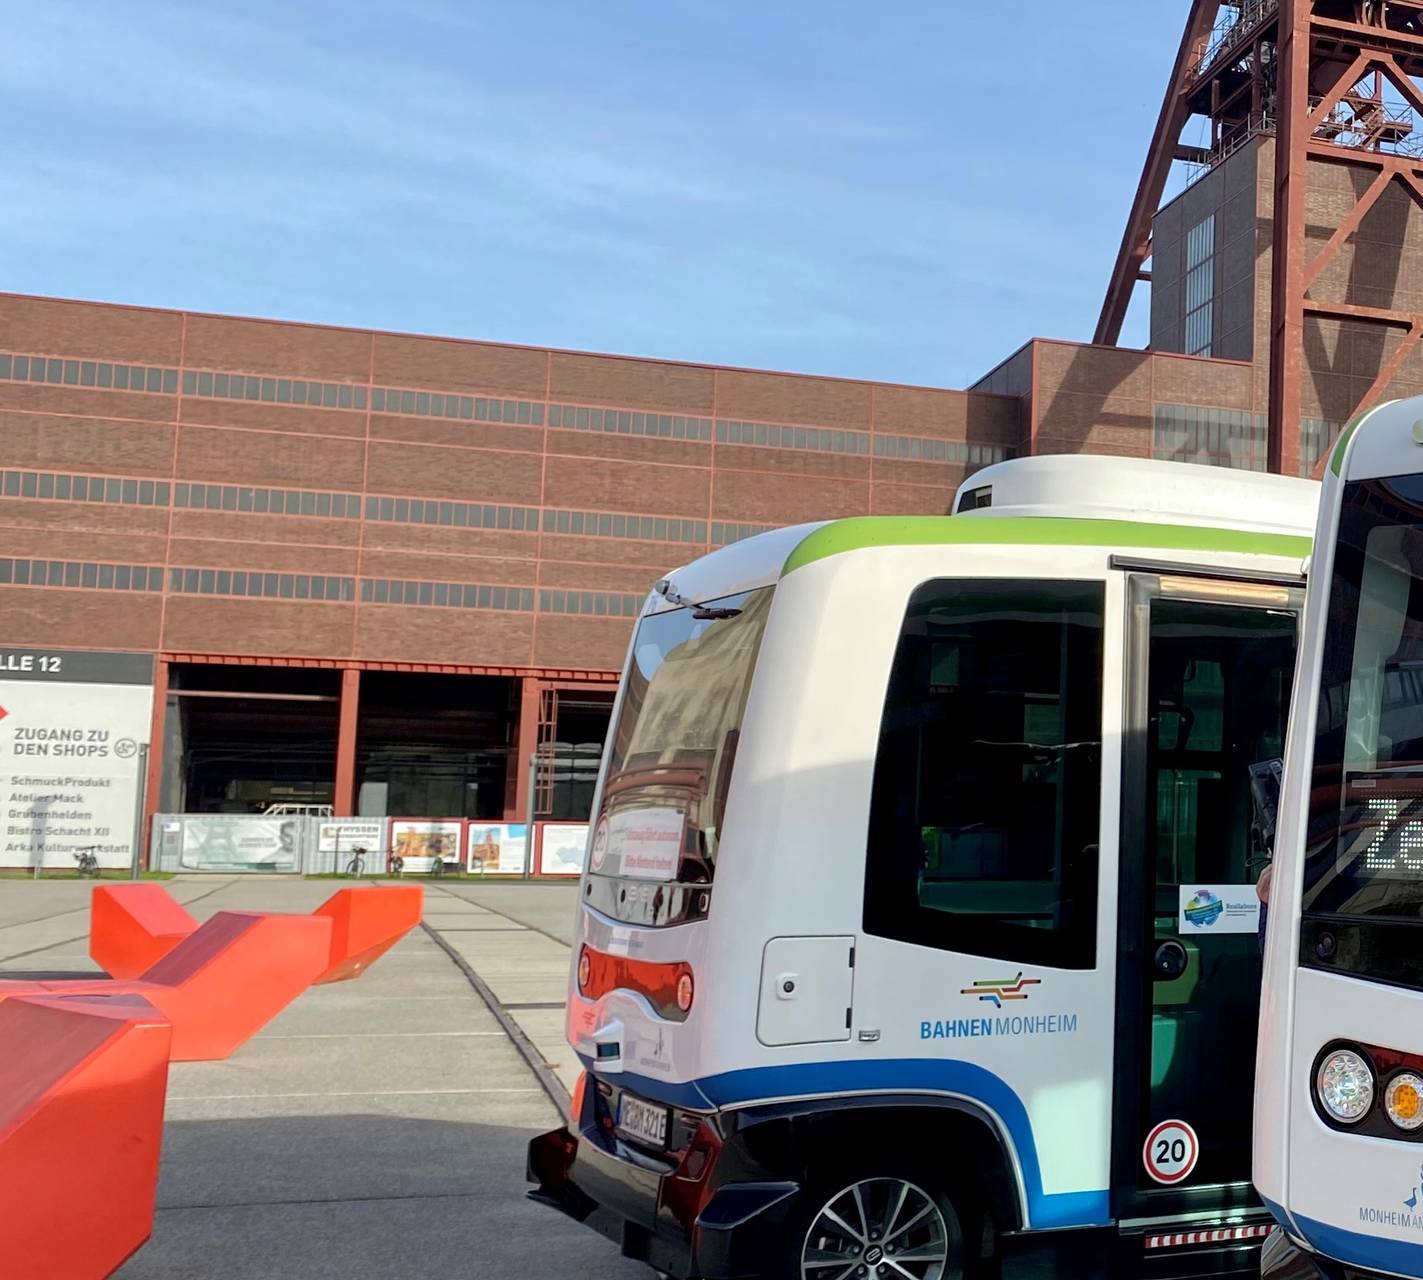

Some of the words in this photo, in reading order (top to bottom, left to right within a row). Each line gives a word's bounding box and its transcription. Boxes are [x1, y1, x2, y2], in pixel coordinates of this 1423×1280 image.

[39, 656, 62, 672] 12
[14, 728, 83, 742] ZUGANG
[87, 730, 109, 742] ZU
[13, 743, 48, 756] DEN
[52, 745, 108, 757] SHOPS
[11, 776, 110, 787] SchmuckProdukt
[8, 809, 92, 820] Grubenhelden
[45, 826, 91, 837] Schacht
[37, 843, 129, 853] Kulturwkstatt
[920, 1017, 992, 1040] BAHNEN
[995, 1013, 1077, 1034] MONHEIM
[1156, 1138, 1186, 1164] 20
[1359, 1207, 1411, 1227] MONHEIM
